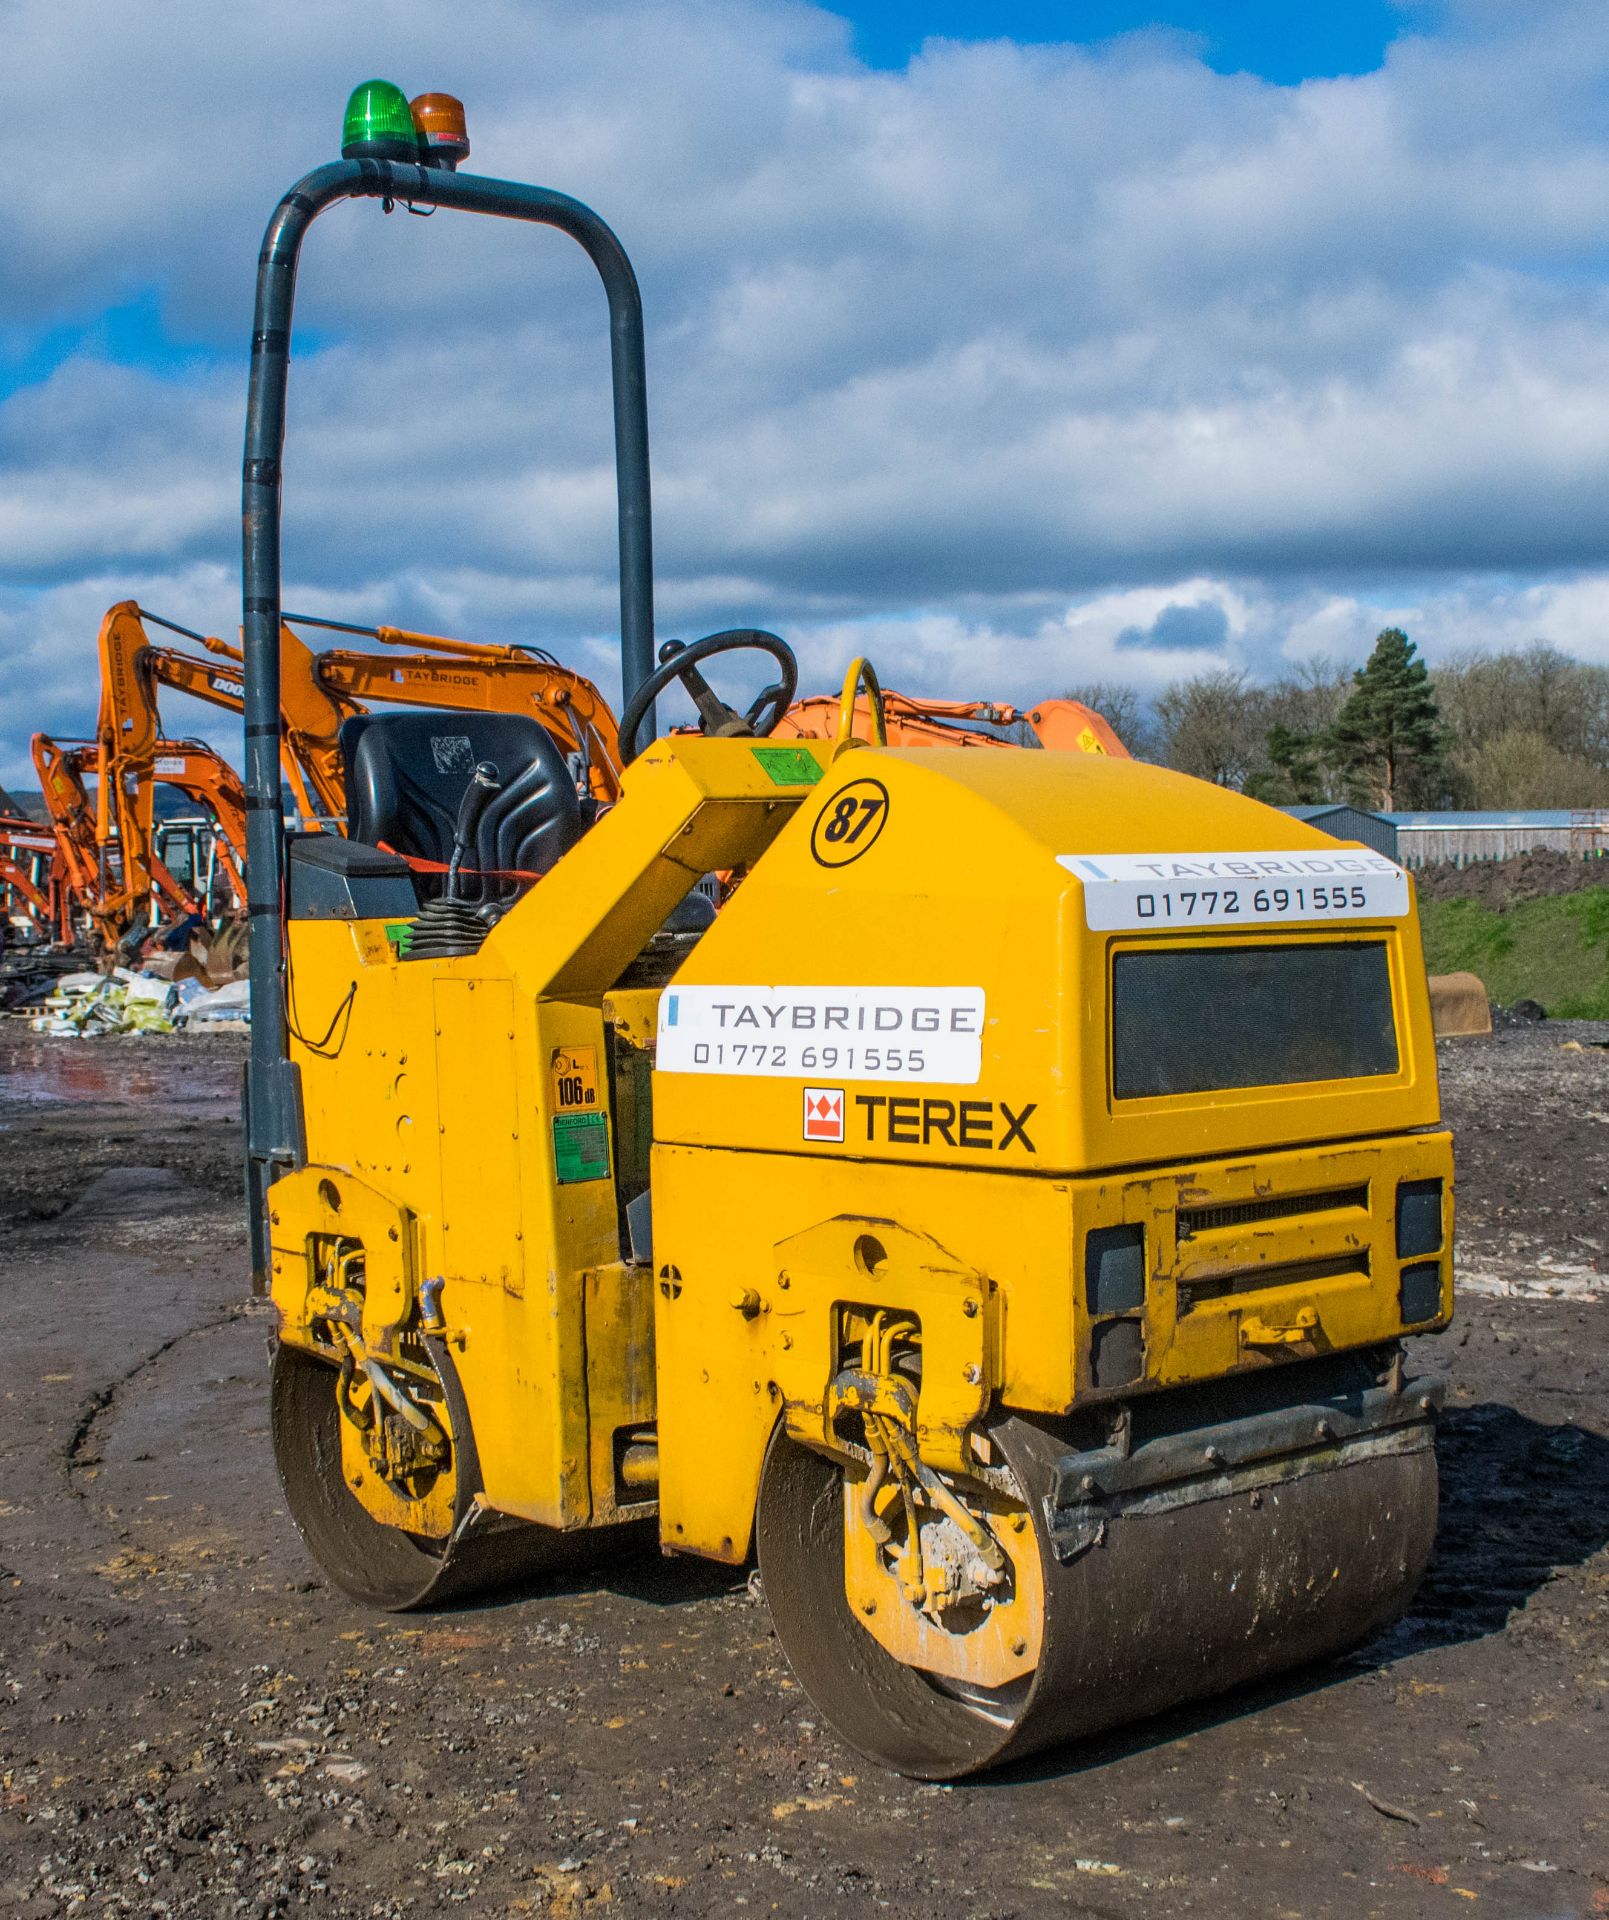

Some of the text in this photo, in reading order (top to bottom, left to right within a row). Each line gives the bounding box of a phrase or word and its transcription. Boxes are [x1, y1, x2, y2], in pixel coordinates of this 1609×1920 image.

[406, 670, 480, 686] TAYBRIDGE
[824, 796, 885, 844] 87
[1135, 857, 1399, 879] TAYBRIDGE
[1136, 886, 1367, 918] 01772 691555
[711, 1004, 977, 1033] TAYBRIDGE
[693, 1043, 925, 1072] 01772 691555
[557, 1076, 596, 1106] 106 dB
[855, 1094, 1038, 1153] TEREX
